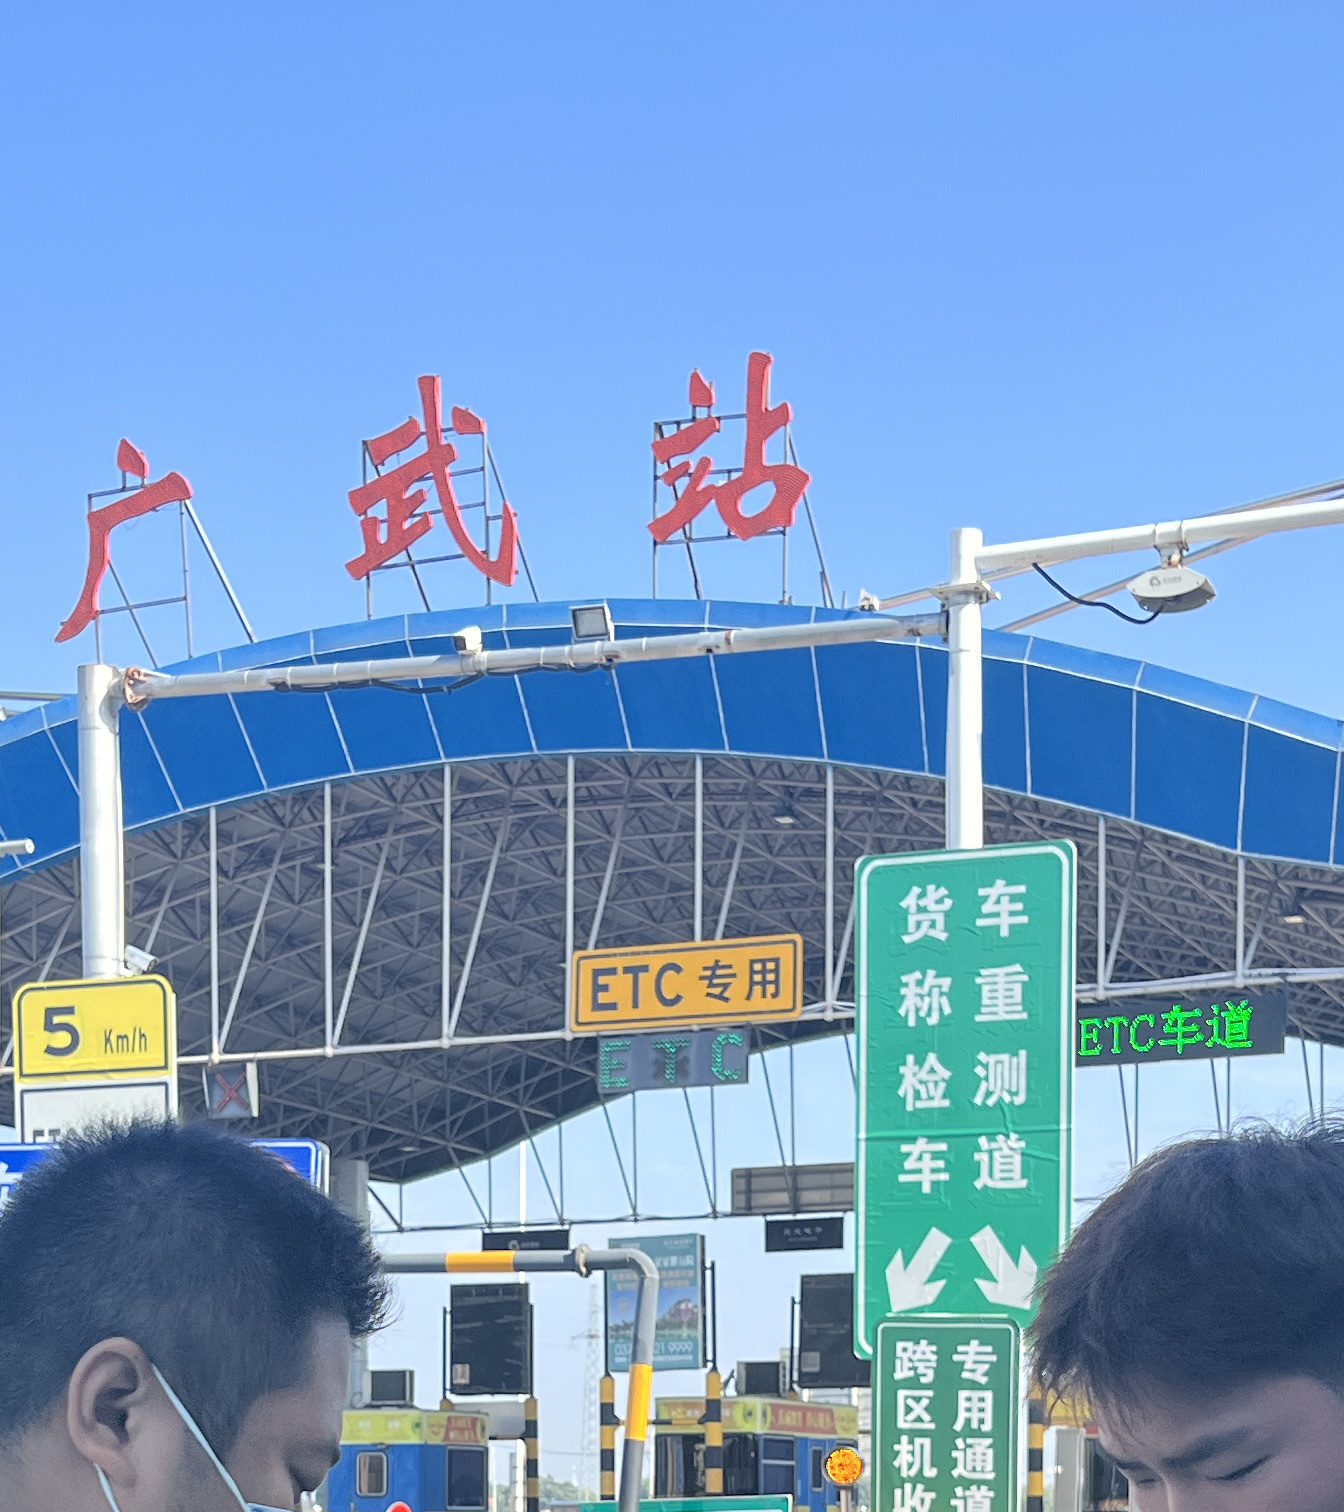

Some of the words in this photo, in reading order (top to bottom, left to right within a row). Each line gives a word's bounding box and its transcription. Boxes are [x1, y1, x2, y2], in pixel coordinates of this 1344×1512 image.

[56, 352, 810, 642] 广武站
[899, 879, 1029, 943] 货车
[591, 957, 781, 1012] ETC专用
[897, 963, 1029, 1028] 称重
[43, 1005, 81, 1057] 5
[104, 1027, 148, 1055] Km/h
[1078, 999, 1253, 1056] ETC车道
[600, 1032, 744, 1089] ETC
[897, 1049, 1028, 1111] 检测
[897, 1132, 1029, 1194] 车道
